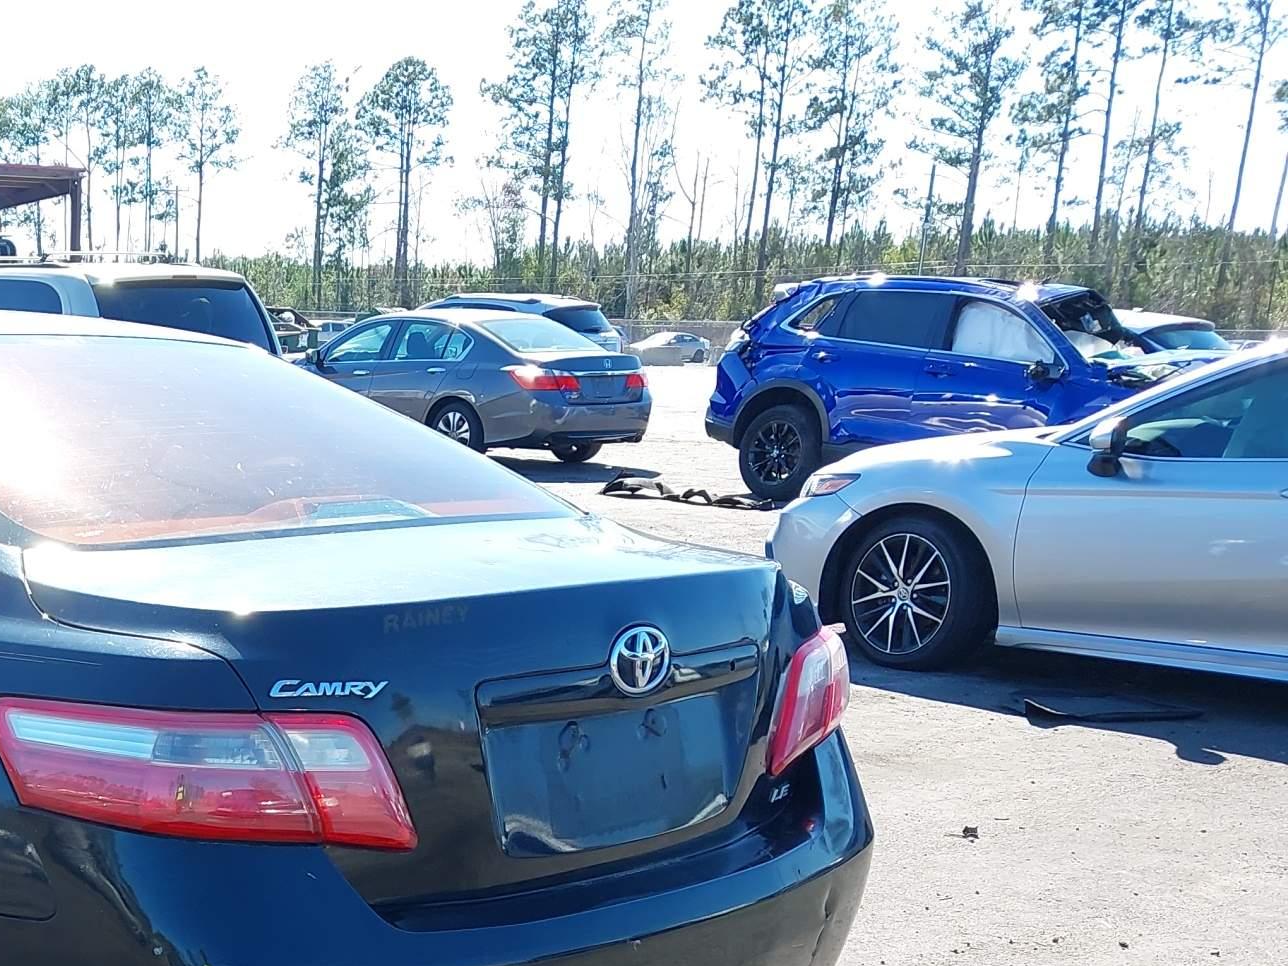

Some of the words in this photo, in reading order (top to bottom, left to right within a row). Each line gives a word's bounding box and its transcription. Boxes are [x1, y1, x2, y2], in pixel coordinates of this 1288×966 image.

[383, 605, 471, 634] RAINEY
[269, 679, 389, 699] CAMRY
[770, 783, 790, 803] LE
